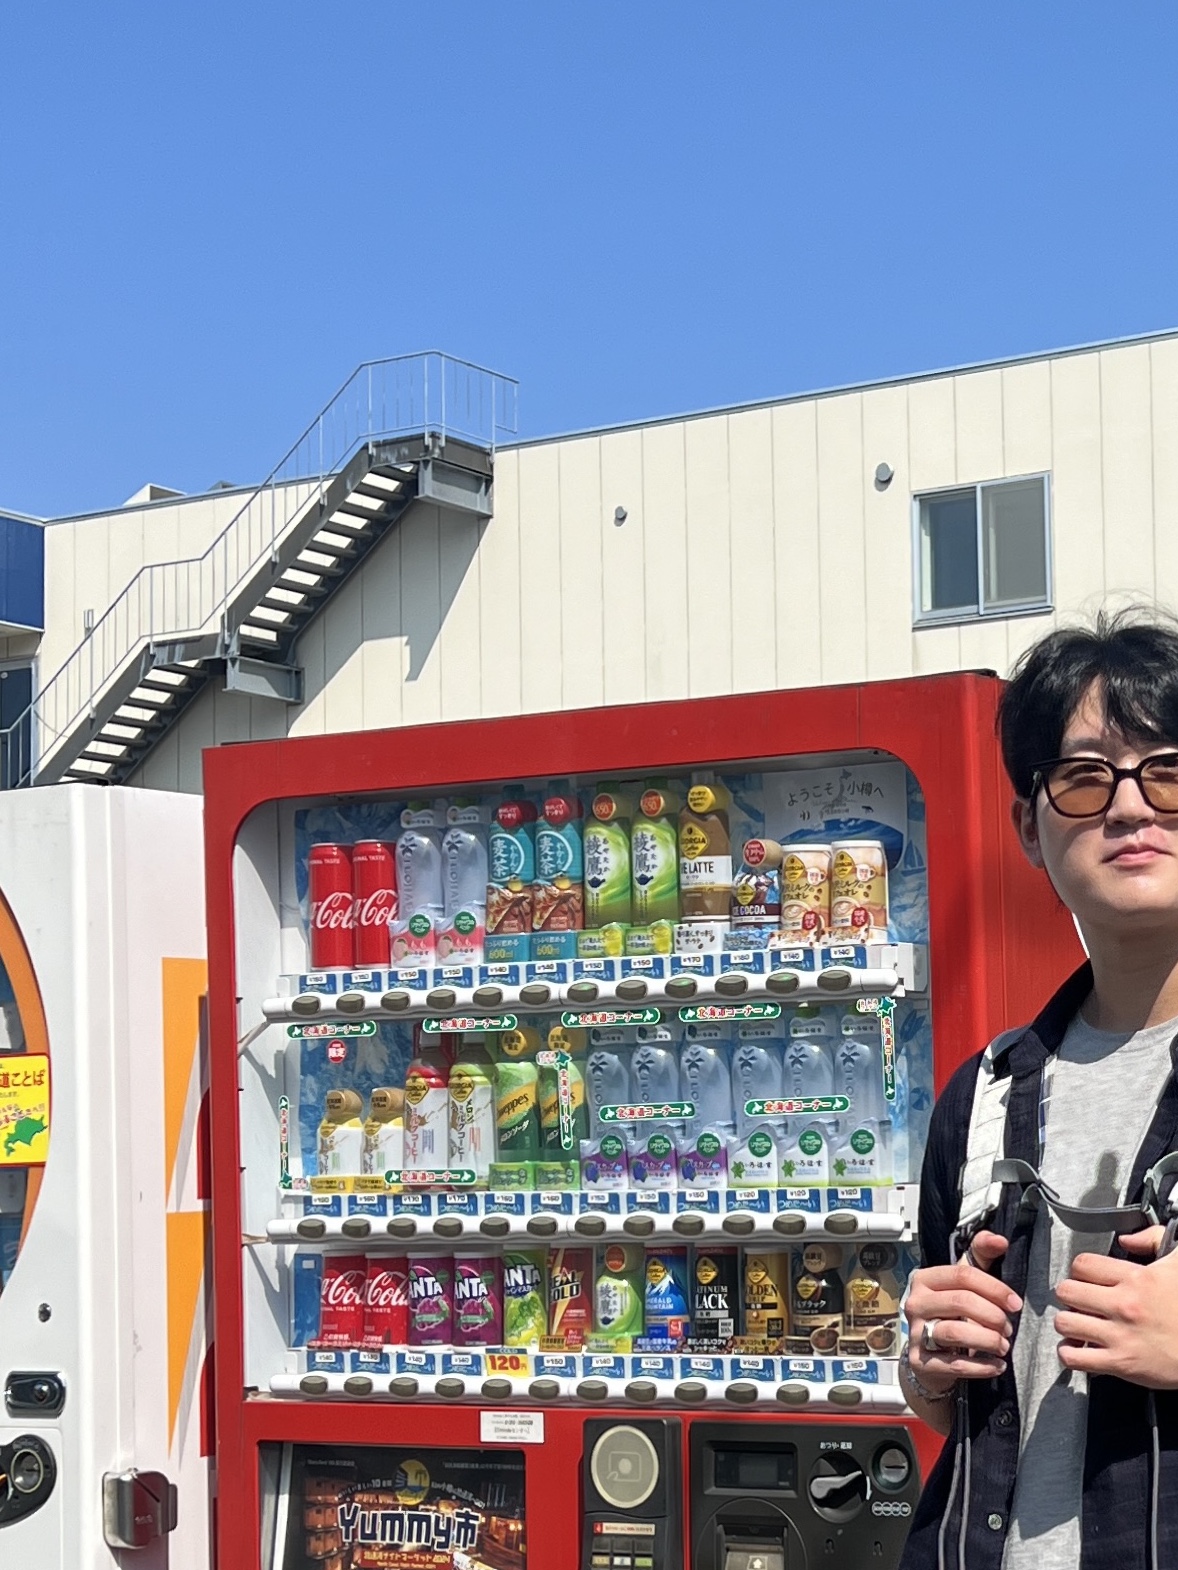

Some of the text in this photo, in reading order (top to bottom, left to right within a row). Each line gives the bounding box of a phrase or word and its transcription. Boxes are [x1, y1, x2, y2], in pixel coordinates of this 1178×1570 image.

[788, 781, 884, 806] ようこそ 小樽へ
[492, 838, 508, 876] 麦茶
[539, 836, 556, 874] 麦茶
[586, 835, 602, 876] 綾鷹
[634, 832, 651, 873] 綾鷹
[688, 861, 714, 873] LATTE
[740, 906, 766, 916] COCOA
[465, 1098, 475, 1124] メロン
[504, 1264, 541, 1287] ANTA
[552, 1271, 578, 1286] EAL
[409, 1276, 443, 1299] ANTA
[455, 1277, 488, 1299] ANTA
[695, 1294, 729, 1309] LACK
[488, 1354, 528, 1371] 120円
[338, 1502, 480, 1552] Yummy市
